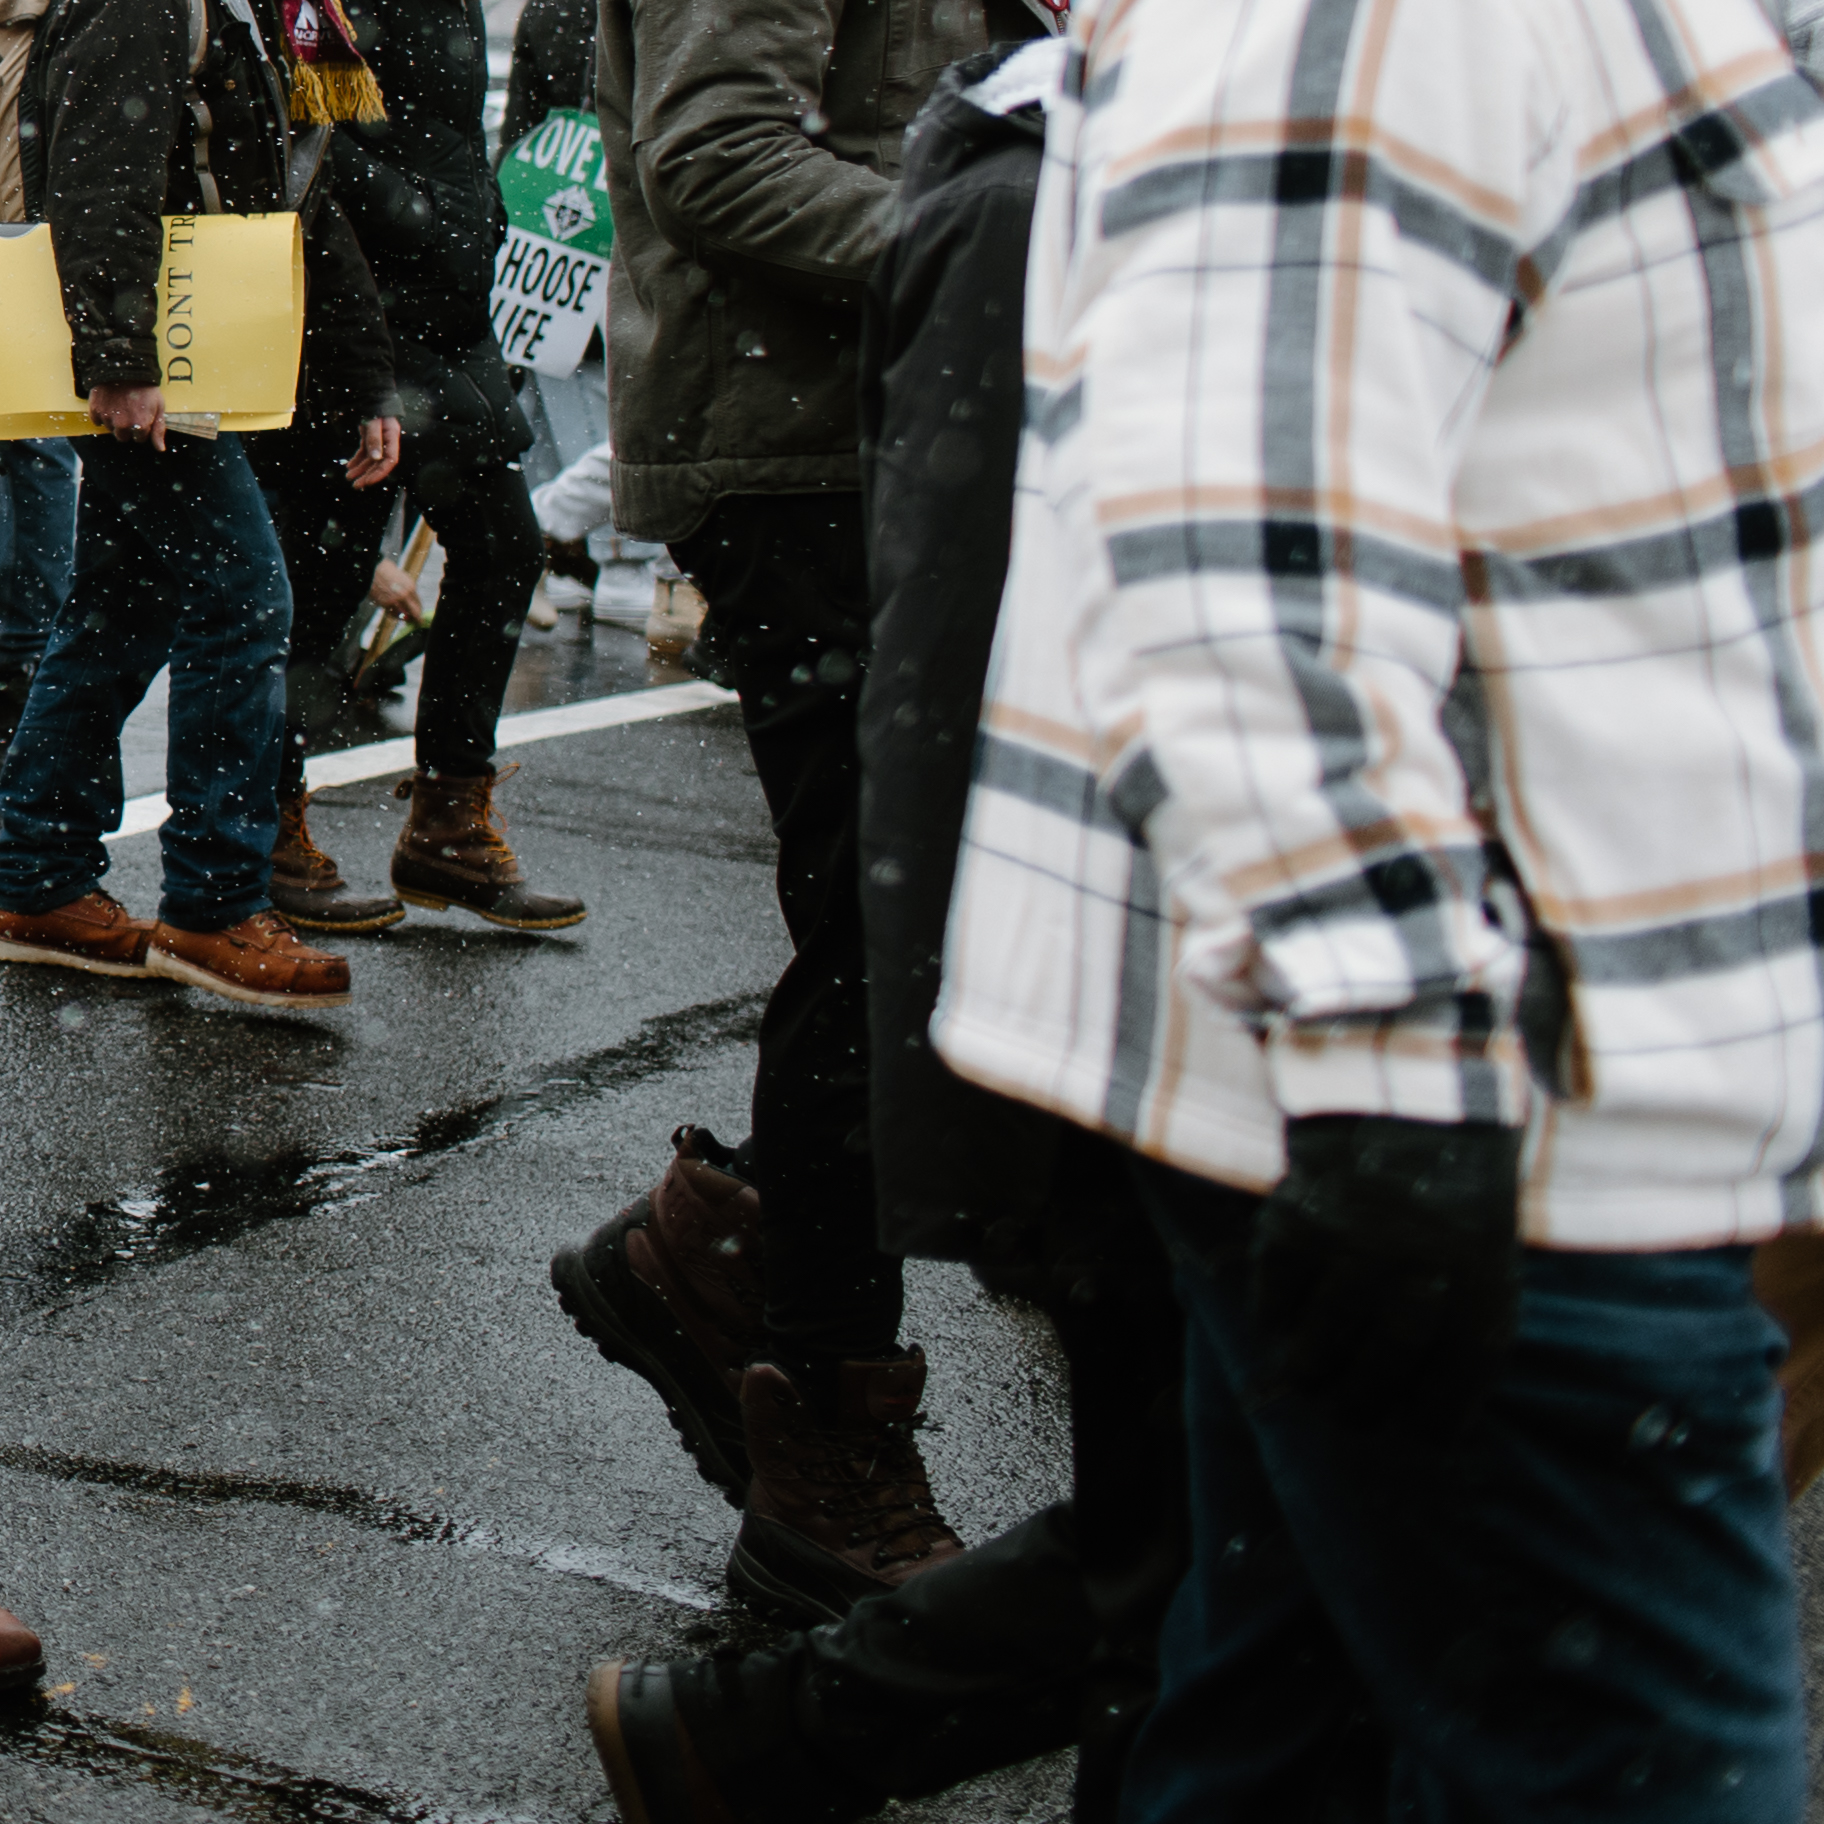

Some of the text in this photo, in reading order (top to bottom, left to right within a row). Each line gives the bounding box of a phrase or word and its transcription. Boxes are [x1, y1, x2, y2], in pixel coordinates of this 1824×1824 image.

[516, 116, 601, 183] LOVE
[497, 237, 602, 313] HOOSE
[167, 267, 194, 384] DONT
